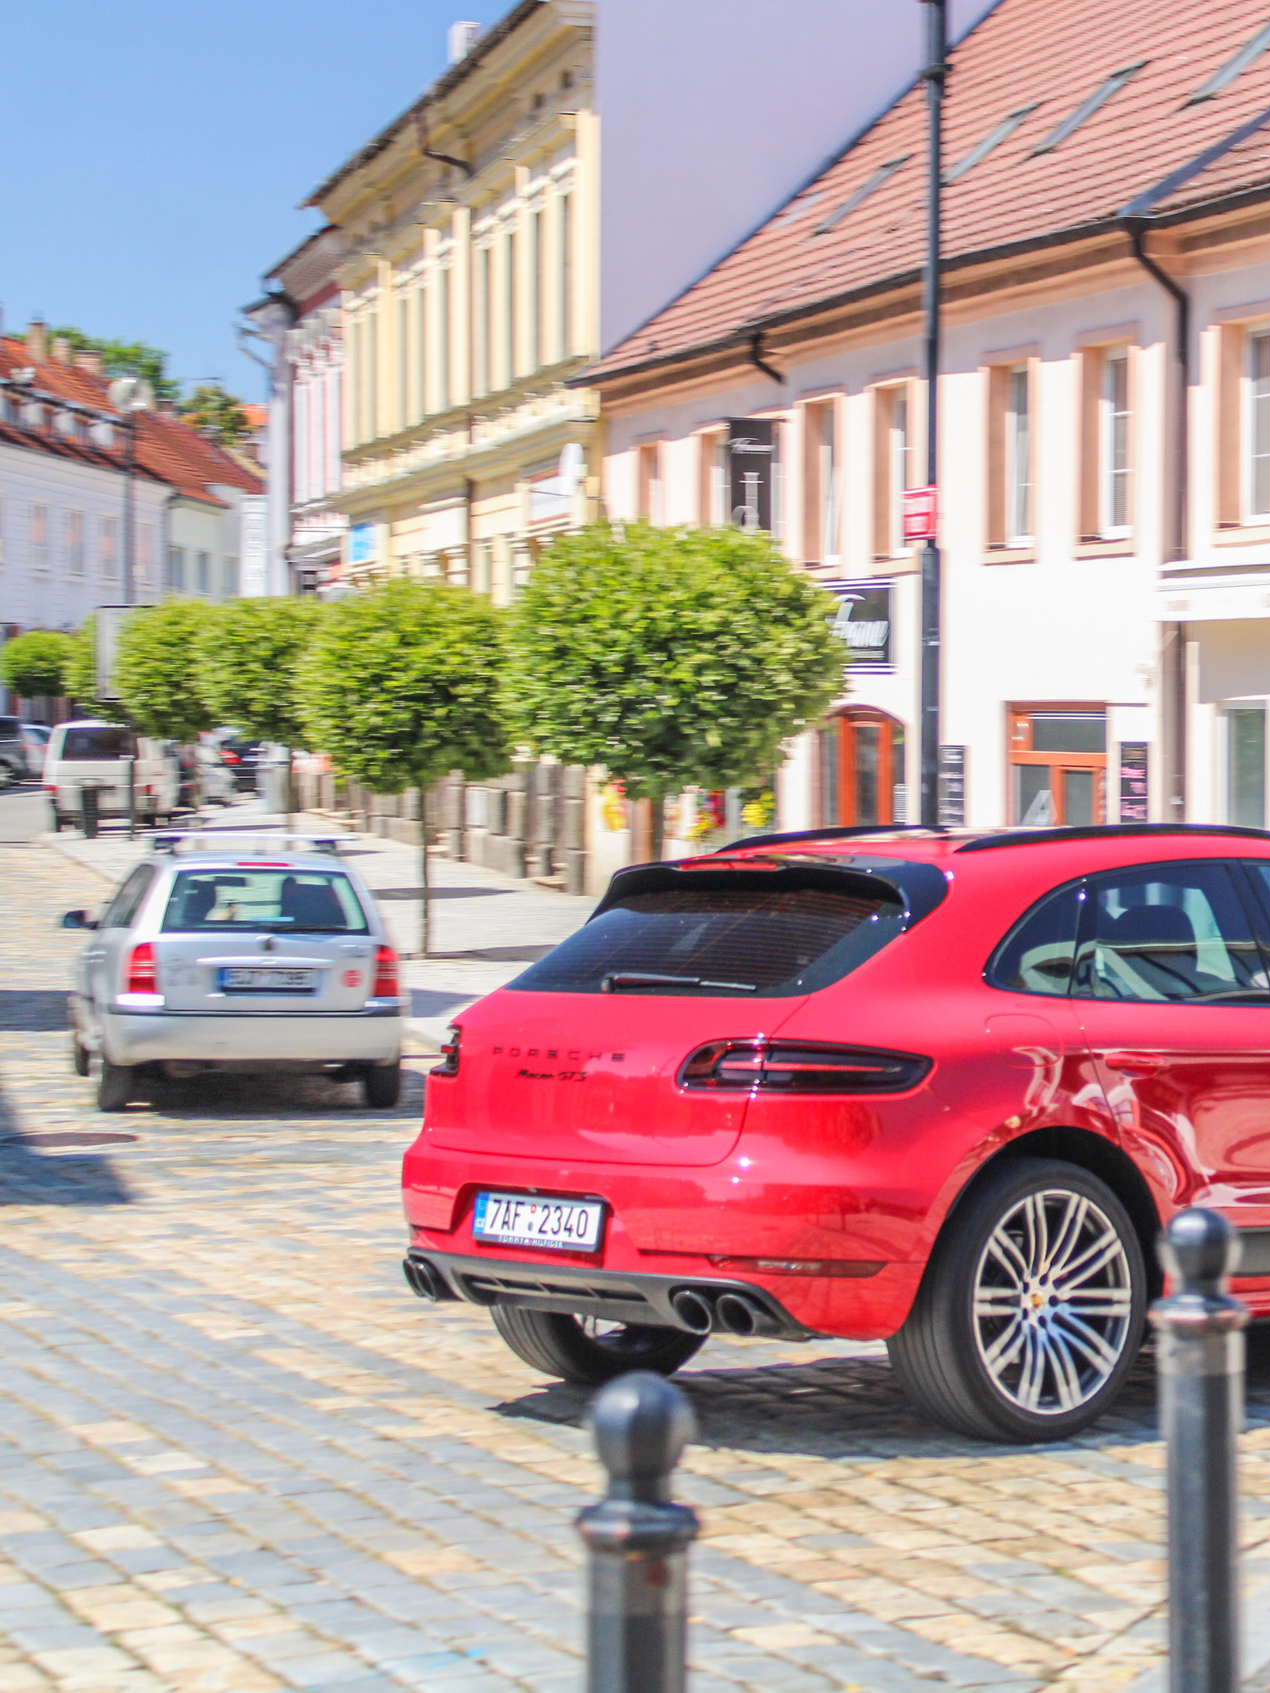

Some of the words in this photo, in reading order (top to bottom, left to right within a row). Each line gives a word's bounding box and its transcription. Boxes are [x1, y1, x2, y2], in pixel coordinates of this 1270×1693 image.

[493, 1047, 625, 1062] PORSCHE
[489, 1199, 526, 1231] 7AF
[538, 1204, 589, 1239] 2340
[498, 1235, 524, 1245] TOMMY
[532, 1238, 564, 1248] HILFIGER
